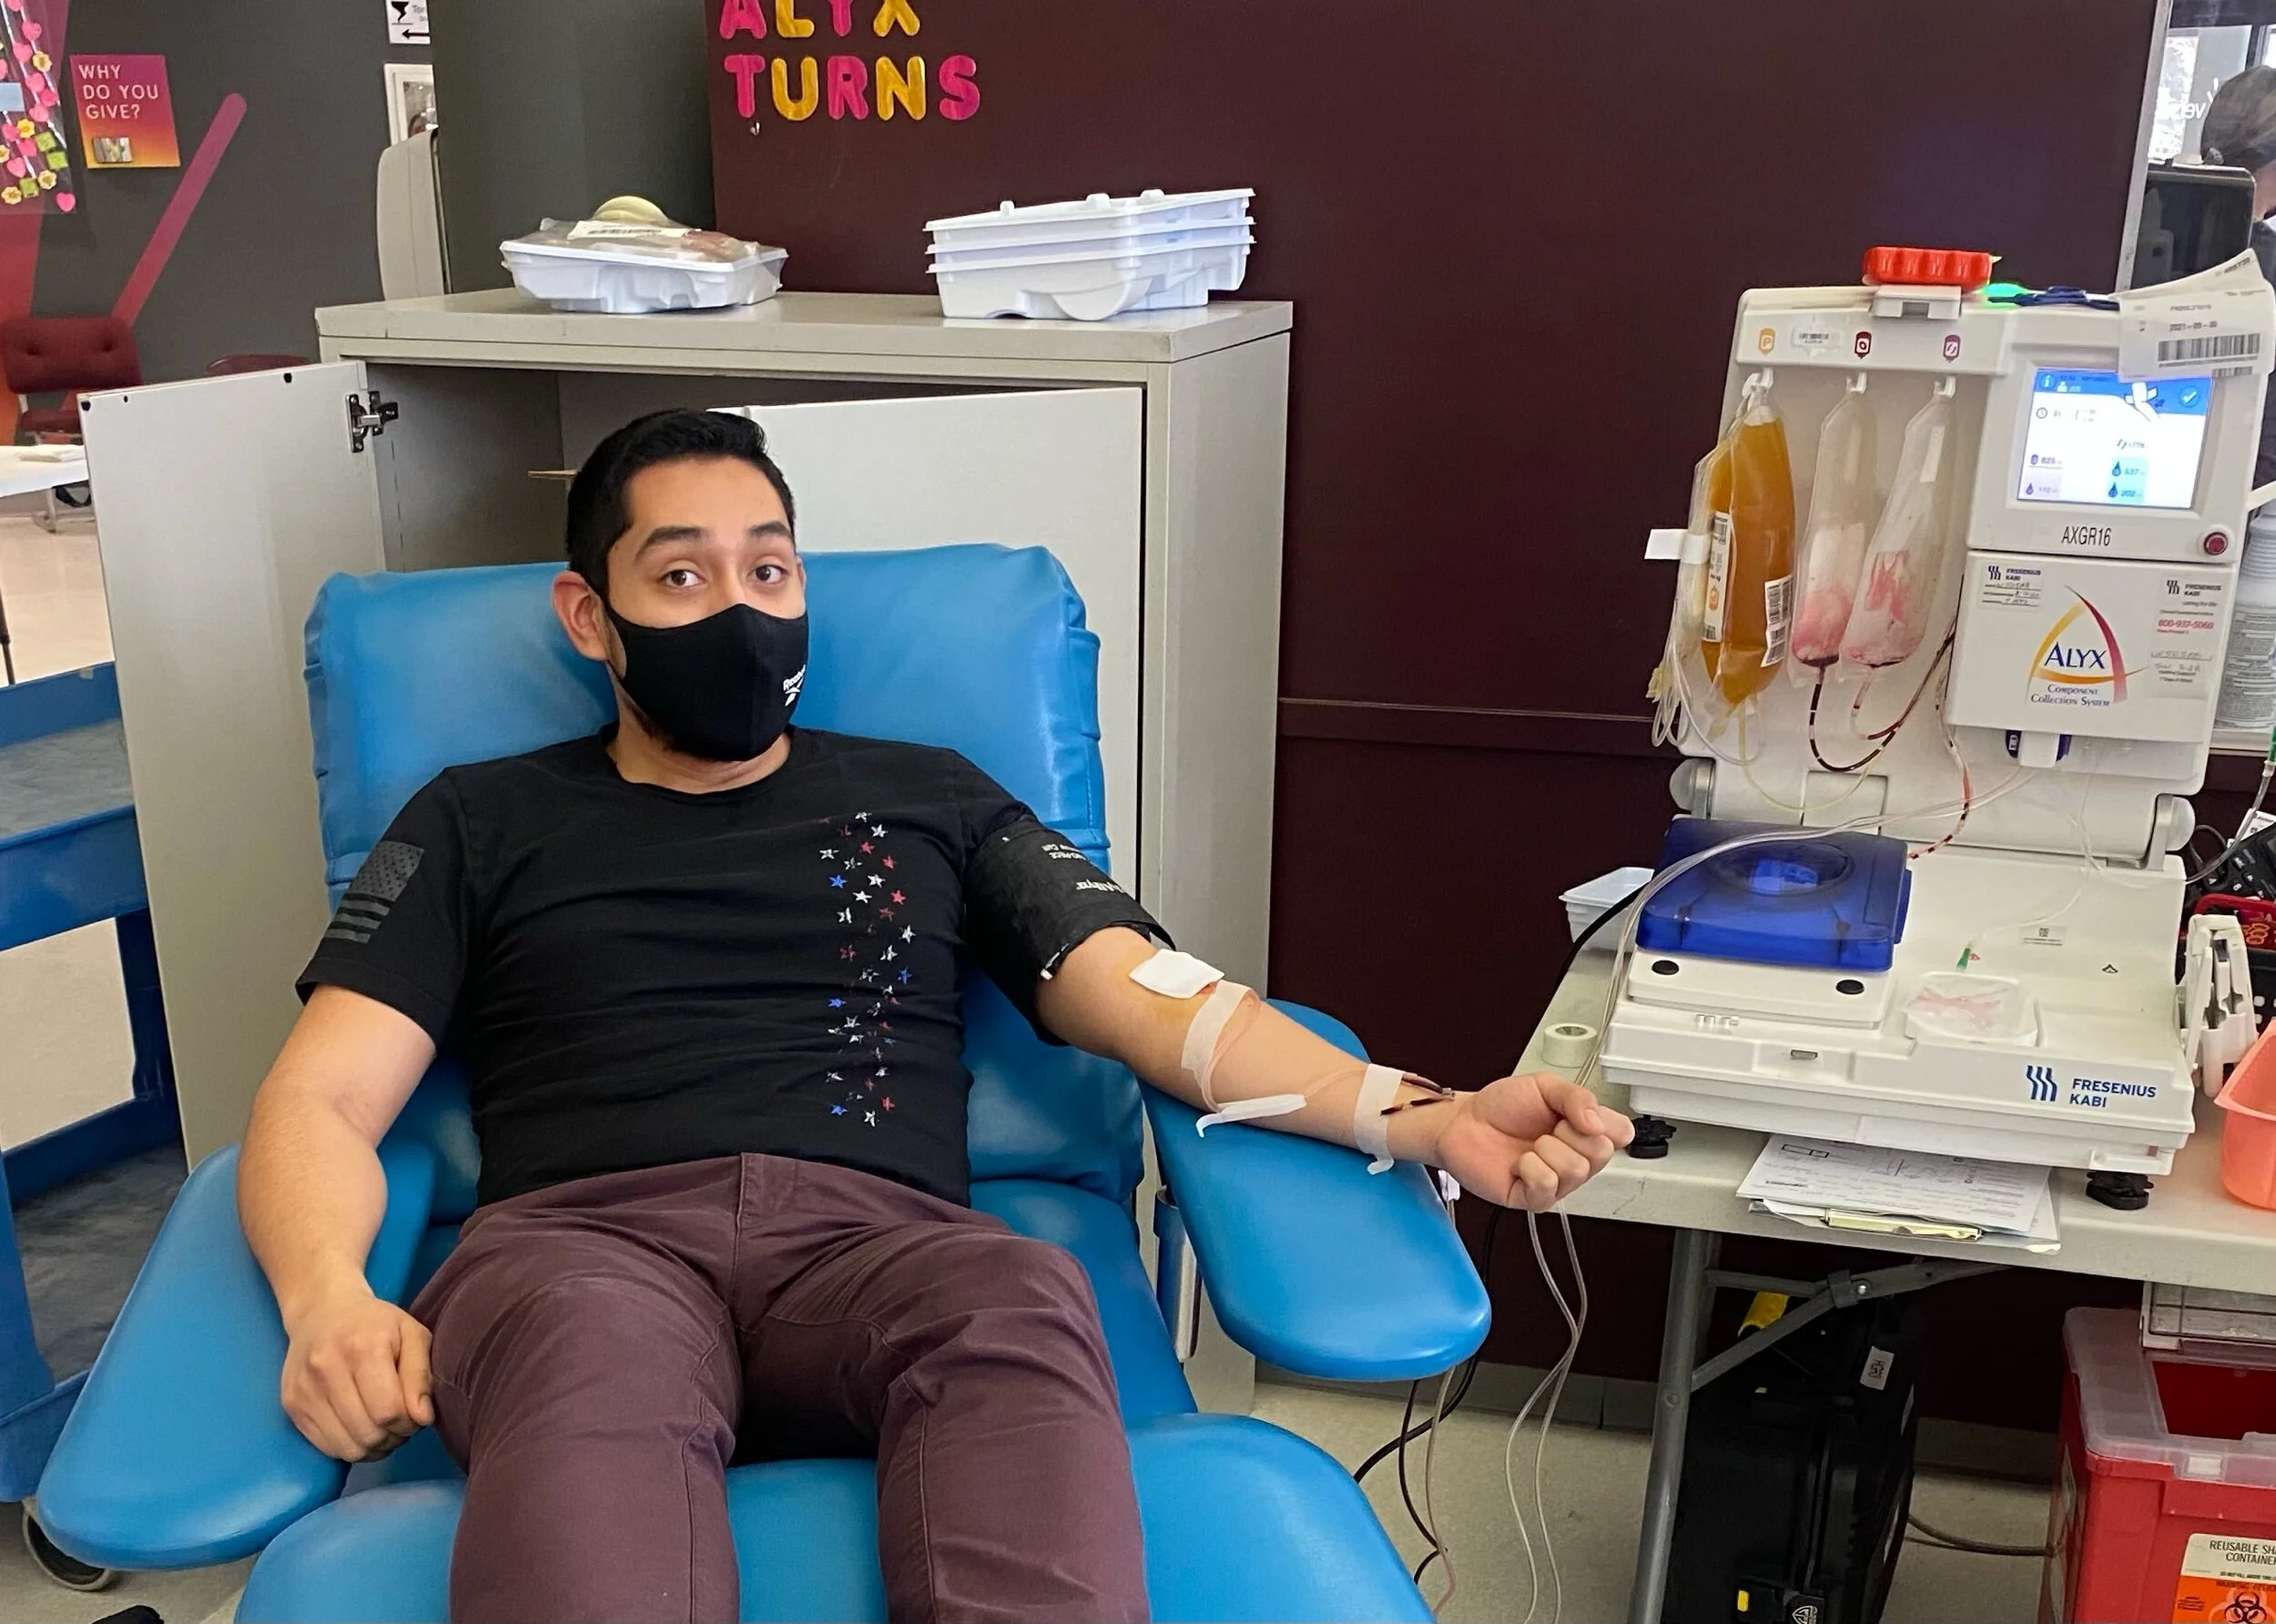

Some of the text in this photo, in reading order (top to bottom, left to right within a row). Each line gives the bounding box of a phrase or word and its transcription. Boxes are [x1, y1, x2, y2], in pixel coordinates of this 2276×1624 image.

[719, 0, 920, 39] ALYX
[78, 64, 121, 79] WHY
[83, 84, 159, 100] DO YOU
[724, 55, 981, 121] TURNS
[86, 104, 140, 120] GIVE?
[2061, 526, 2111, 546] AXGR16
[2044, 641, 2107, 669] ALYX
[2072, 1078, 2157, 1098] FRESENIUS
[2069, 1093, 2108, 1108] KABI
[2210, 1540, 2259, 1553] REUSABLE
